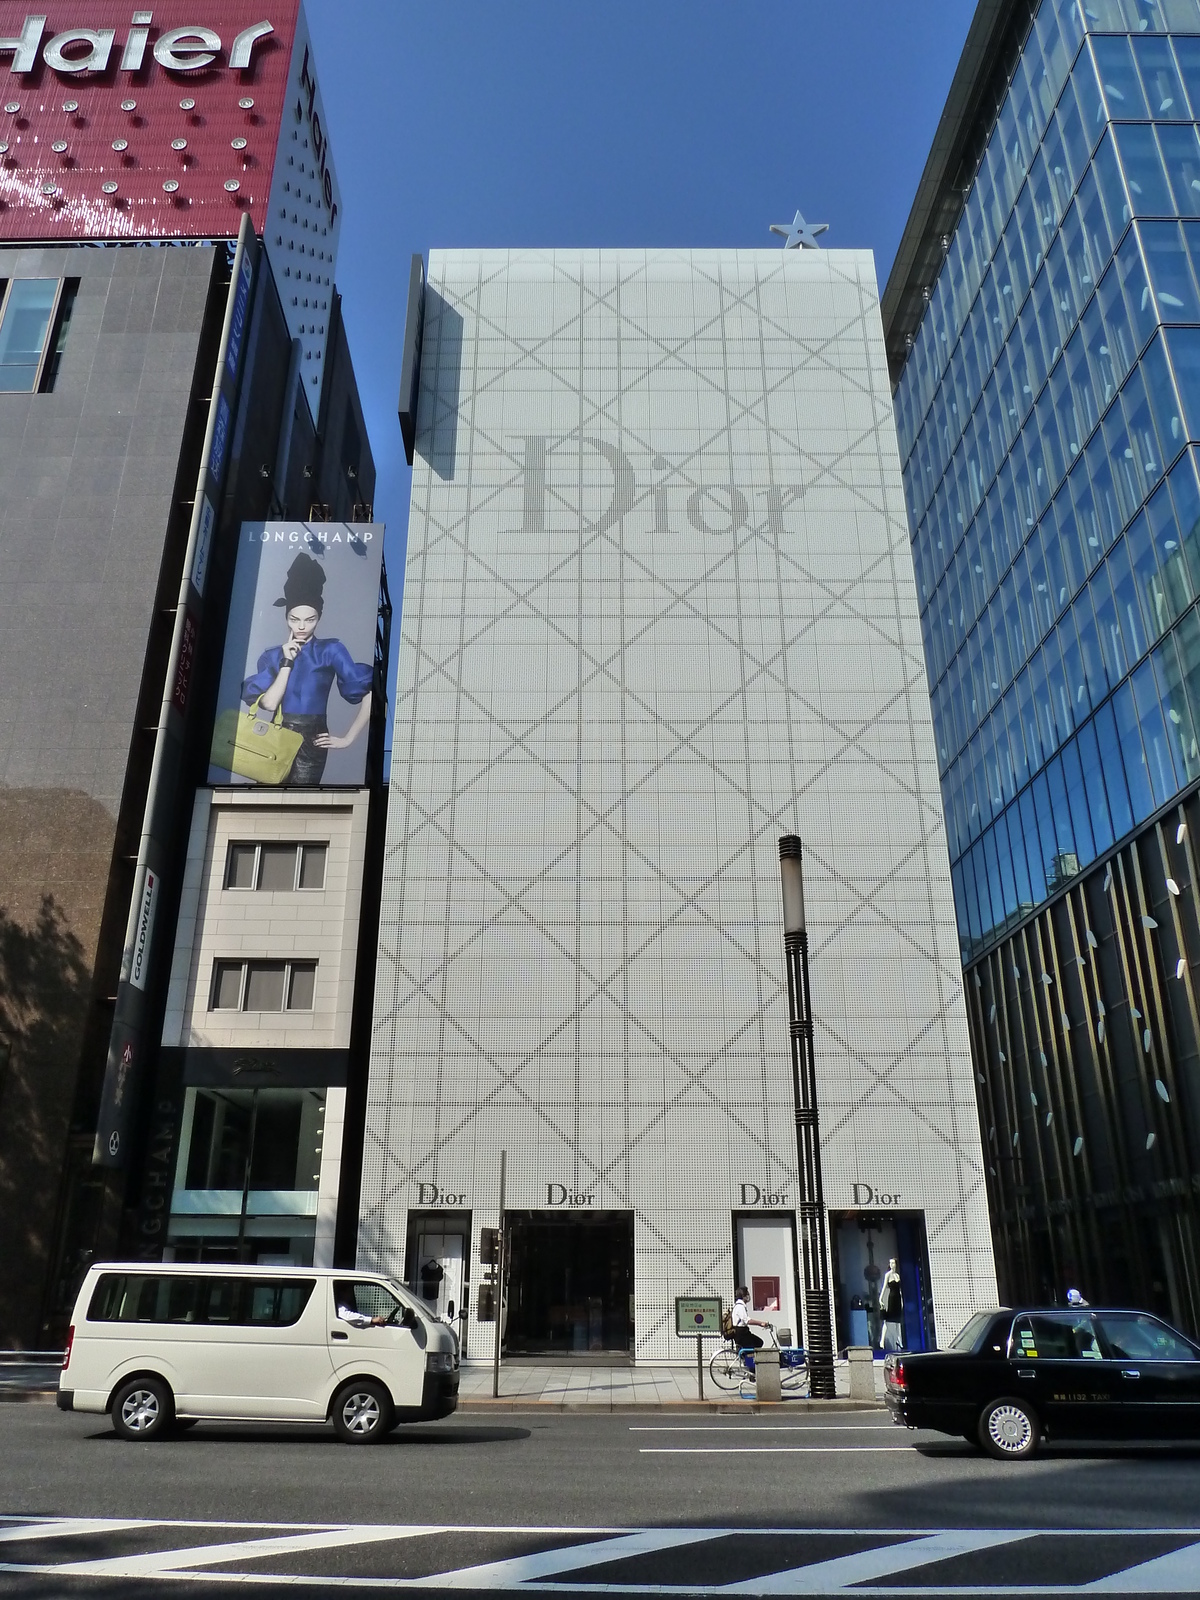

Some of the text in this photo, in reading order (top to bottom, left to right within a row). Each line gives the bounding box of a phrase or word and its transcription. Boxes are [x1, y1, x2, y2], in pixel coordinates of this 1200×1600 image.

[0, 11, 275, 73] Haier
[302, 43, 338, 230] Haier
[497, 434, 808, 536] Dior
[248, 531, 374, 544] LONGCHAMP
[134, 887, 153, 982] GOLDWELL
[416, 1182, 467, 1206] Dior
[545, 1183, 596, 1206] Dior
[739, 1183, 789, 1206] Dior
[851, 1183, 902, 1206] Dior
